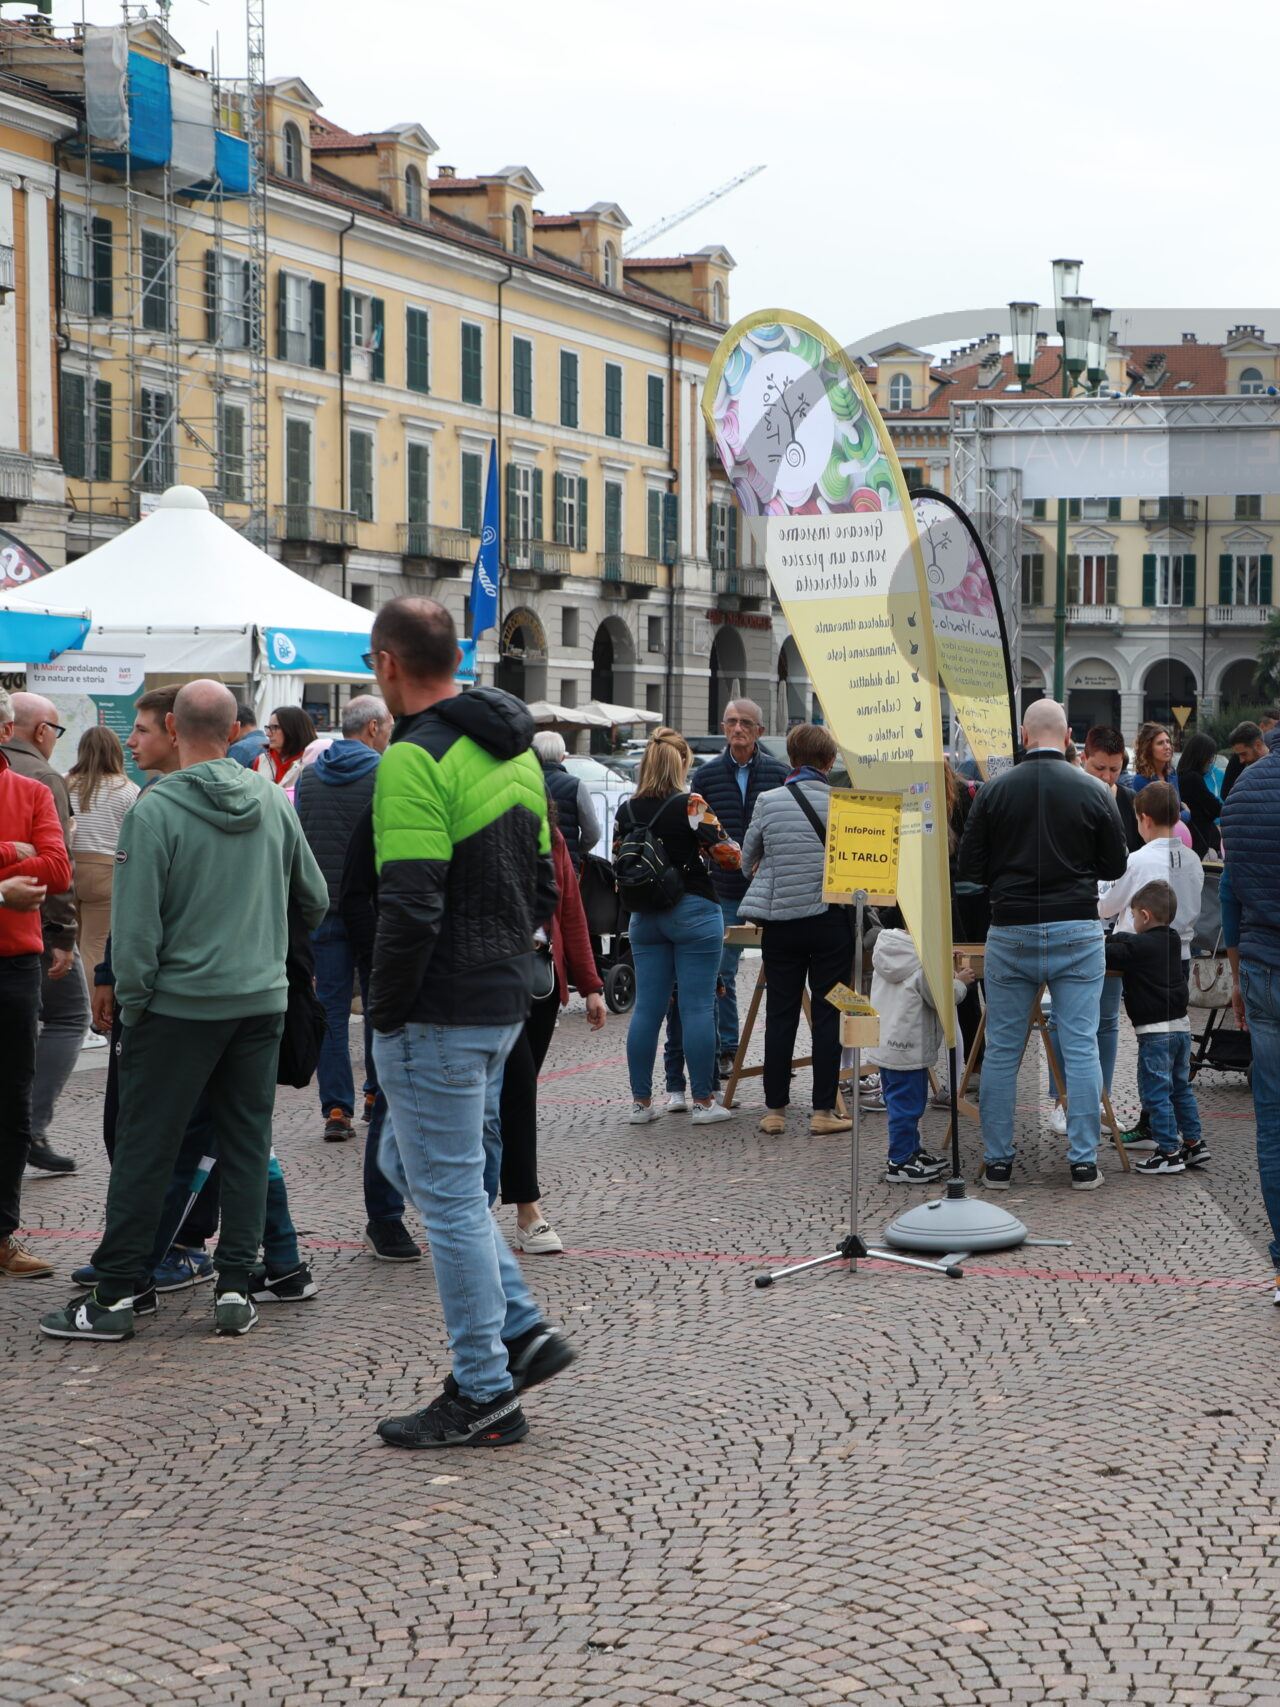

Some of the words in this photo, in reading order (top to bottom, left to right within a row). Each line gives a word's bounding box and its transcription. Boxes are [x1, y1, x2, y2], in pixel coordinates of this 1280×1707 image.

[41, 663, 66, 671] Maira:
[67, 663, 108, 673] pedalando
[47, 675, 74, 683] natura
[82, 675, 105, 684] storia
[844, 825, 886, 836] InfoPoint
[838, 851, 848, 861] IL
[851, 851, 888, 864] TARLO
